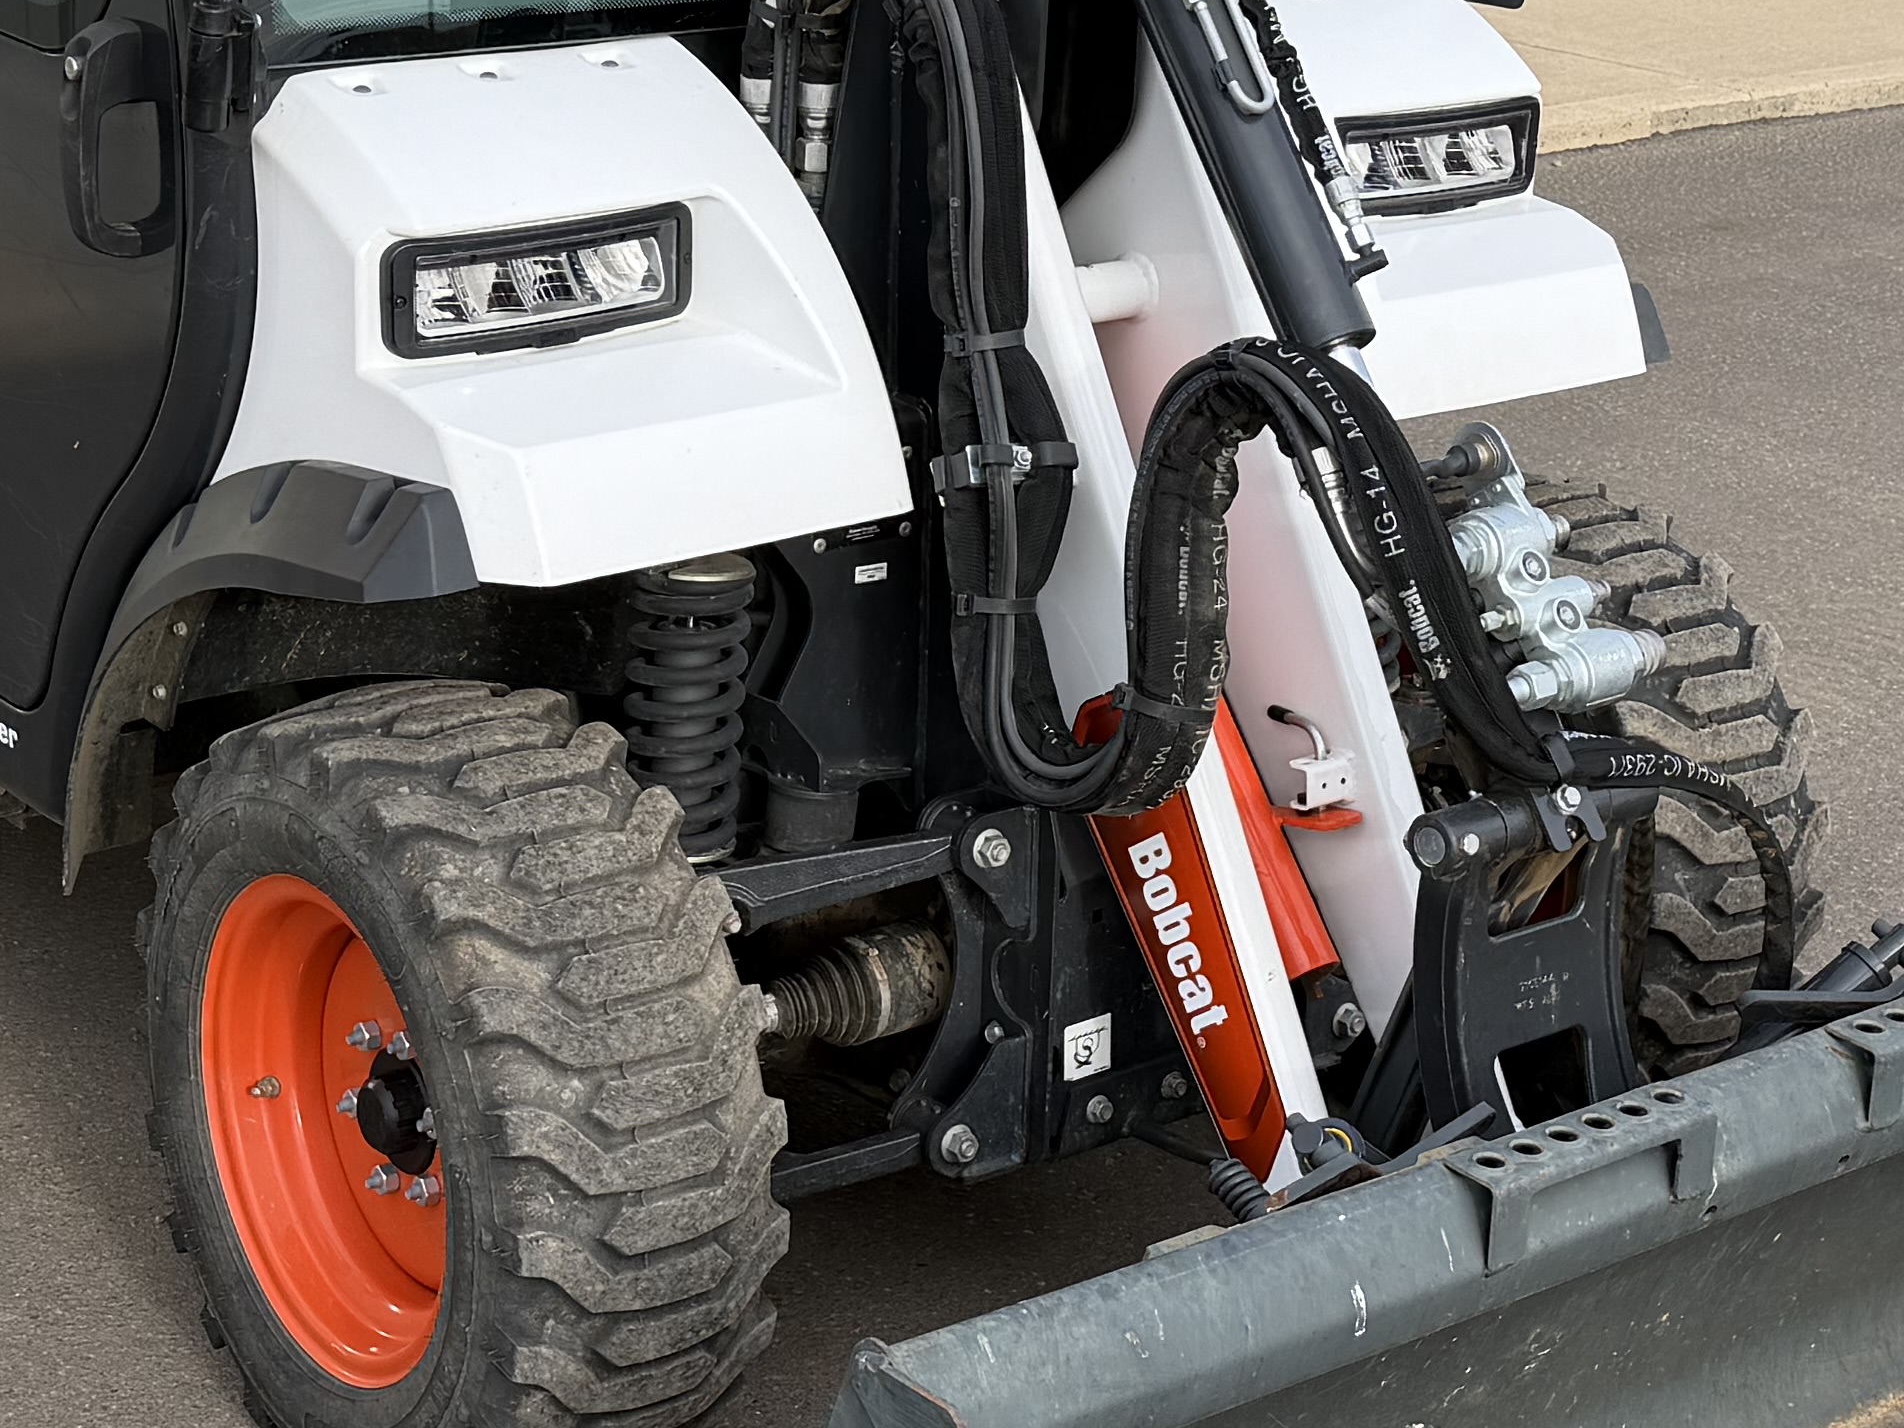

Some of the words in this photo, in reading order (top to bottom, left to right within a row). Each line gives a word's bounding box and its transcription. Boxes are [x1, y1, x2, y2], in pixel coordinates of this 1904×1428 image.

[1360, 464, 1406, 558] HG-14
[1211, 524, 1228, 611] HG-24
[1127, 831, 1228, 1035] Bobcat
